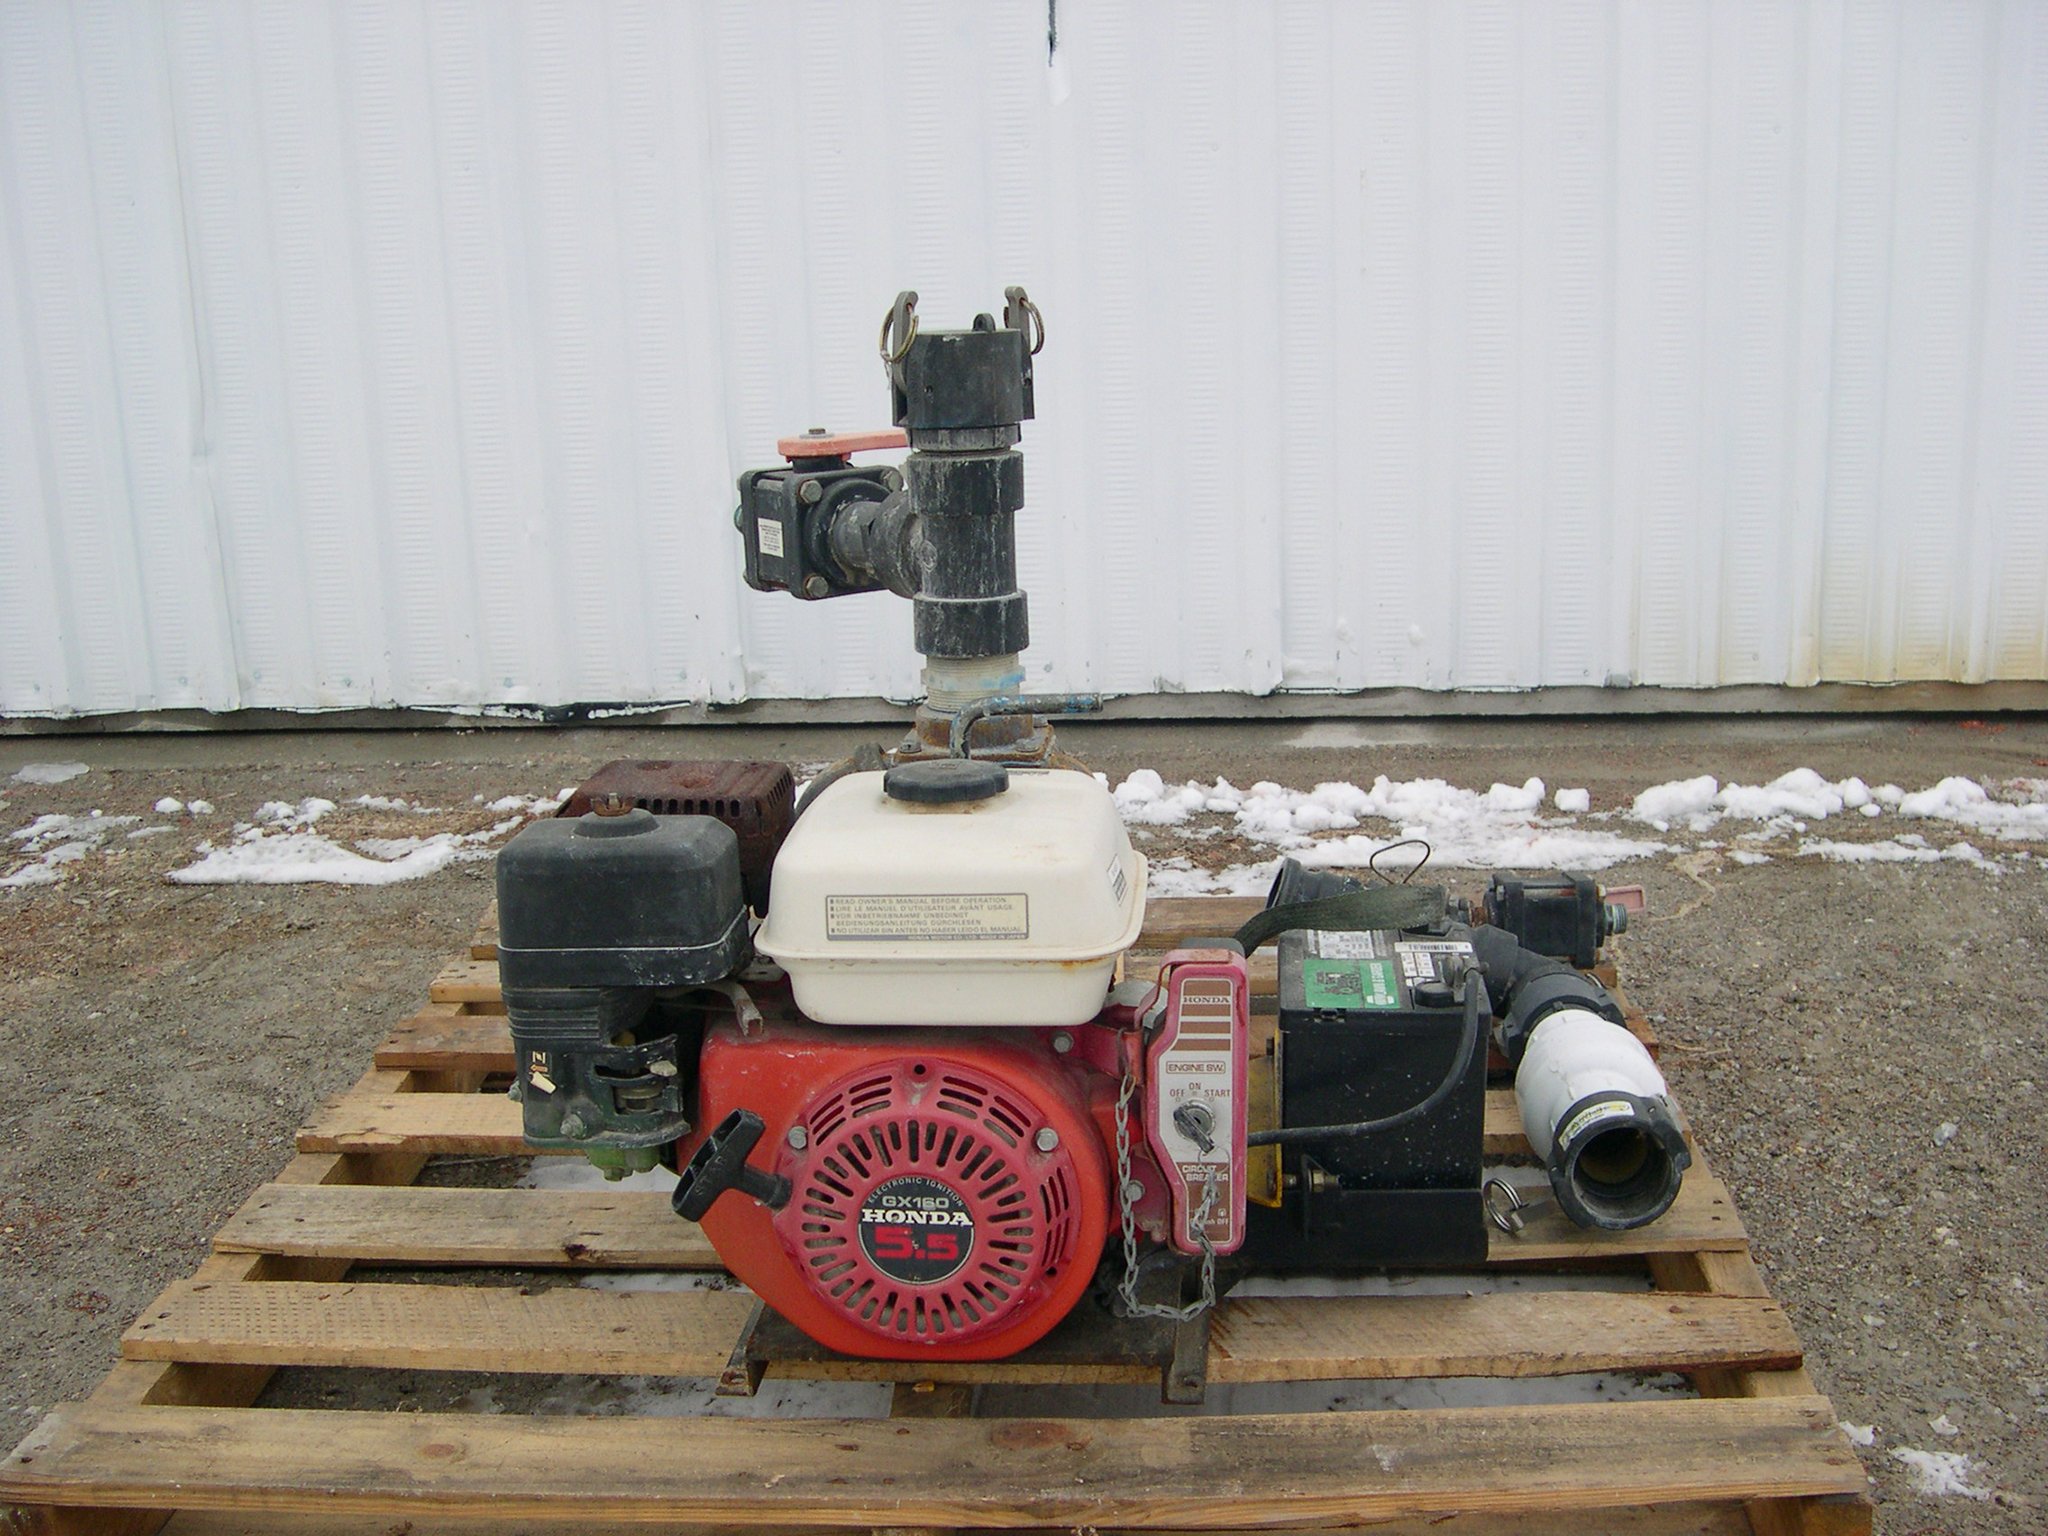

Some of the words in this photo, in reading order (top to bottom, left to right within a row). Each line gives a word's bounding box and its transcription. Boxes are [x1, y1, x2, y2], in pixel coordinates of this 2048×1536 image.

[1170, 1089, 1184, 1097] OFF
[1189, 1082, 1201, 1090] ON
[1204, 1089, 1231, 1097] START
[868, 1177, 922, 1203] ELECTRONIC
[926, 1179, 963, 1206] IGNITION
[882, 1195, 949, 1210] GX160
[862, 1208, 973, 1226] HONDA
[875, 1226, 958, 1260] 5.5
